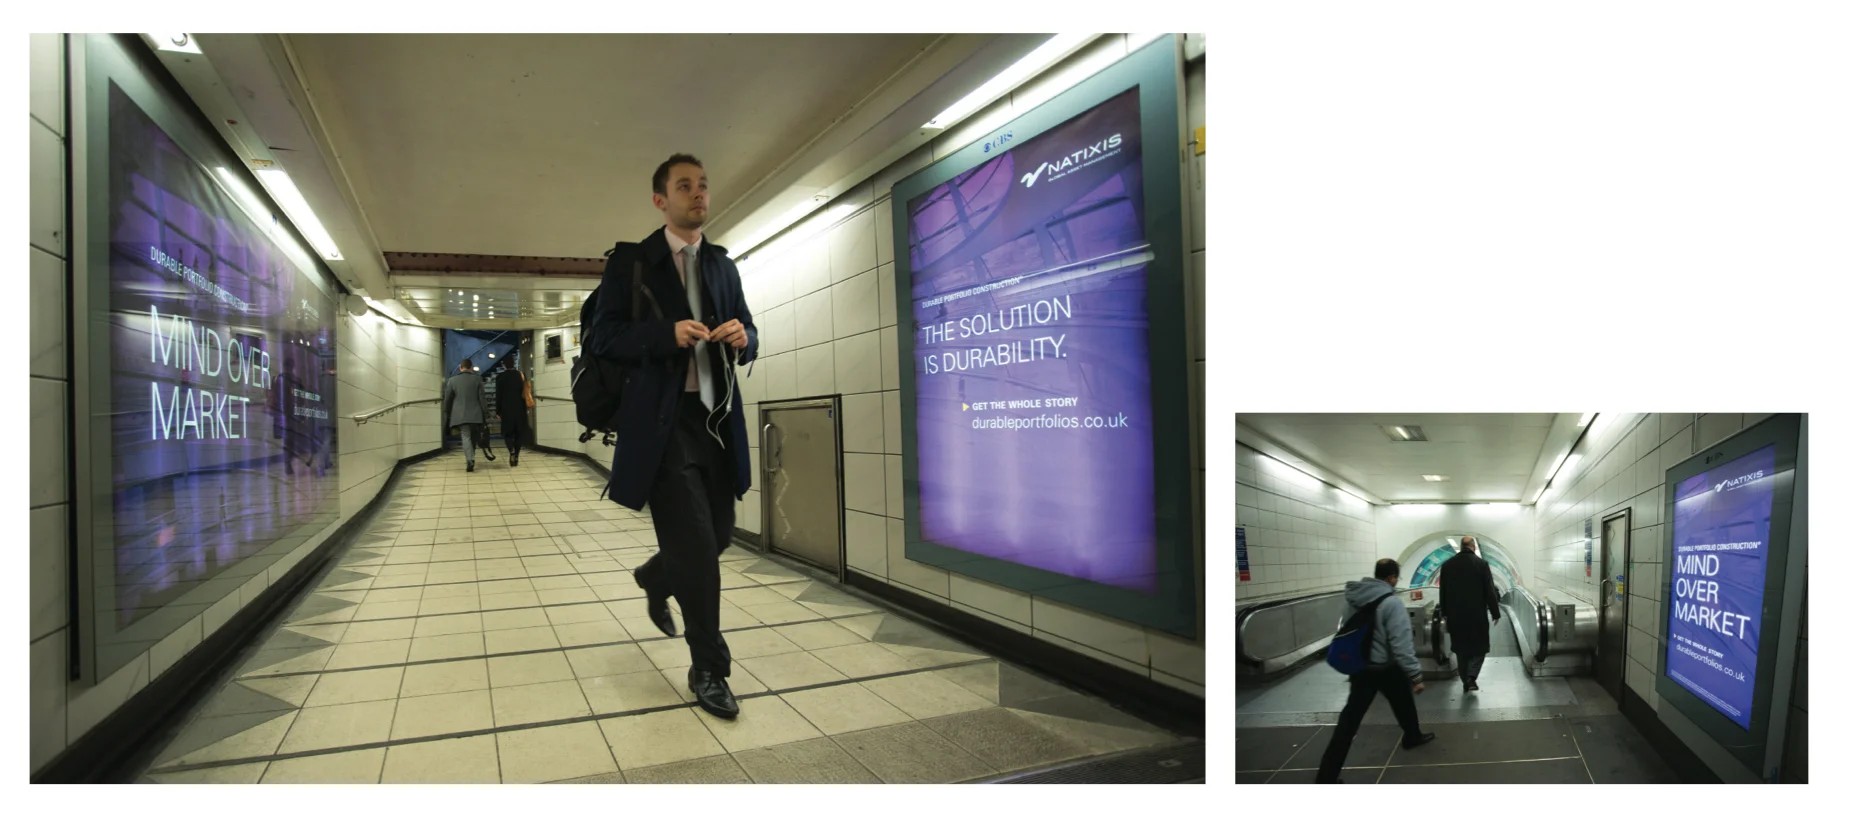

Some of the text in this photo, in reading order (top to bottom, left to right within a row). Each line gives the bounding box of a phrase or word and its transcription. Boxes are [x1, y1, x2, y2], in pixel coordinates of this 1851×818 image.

[992, 130, 1013, 148] CBS
[1047, 133, 1122, 176] NATIXIS
[150, 245, 183, 277] DURABLE
[183, 265, 214, 294] PORTFOLIO
[922, 298, 944, 309] DURABLE
[943, 290, 972, 302] PORTFOLIO
[922, 294, 1071, 345] THE SOLUTION
[151, 304, 272, 390] MIND OVER
[923, 333, 1067, 375] IS DURABILITY.
[151, 381, 250, 440] MARKET
[972, 397, 1078, 411] GET THE WHOLE STORY
[972, 412, 1128, 431] durableportfolios.co.uk
[1727, 469, 1764, 488] NATIXIS
[1677, 554, 1720, 577] MIND
[1676, 577, 1719, 604] OVER
[1674, 600, 1751, 640] MARKET
[1676, 644, 1745, 682] durableportfolios.co.uk
[1708, 648, 1724, 659] STORY
